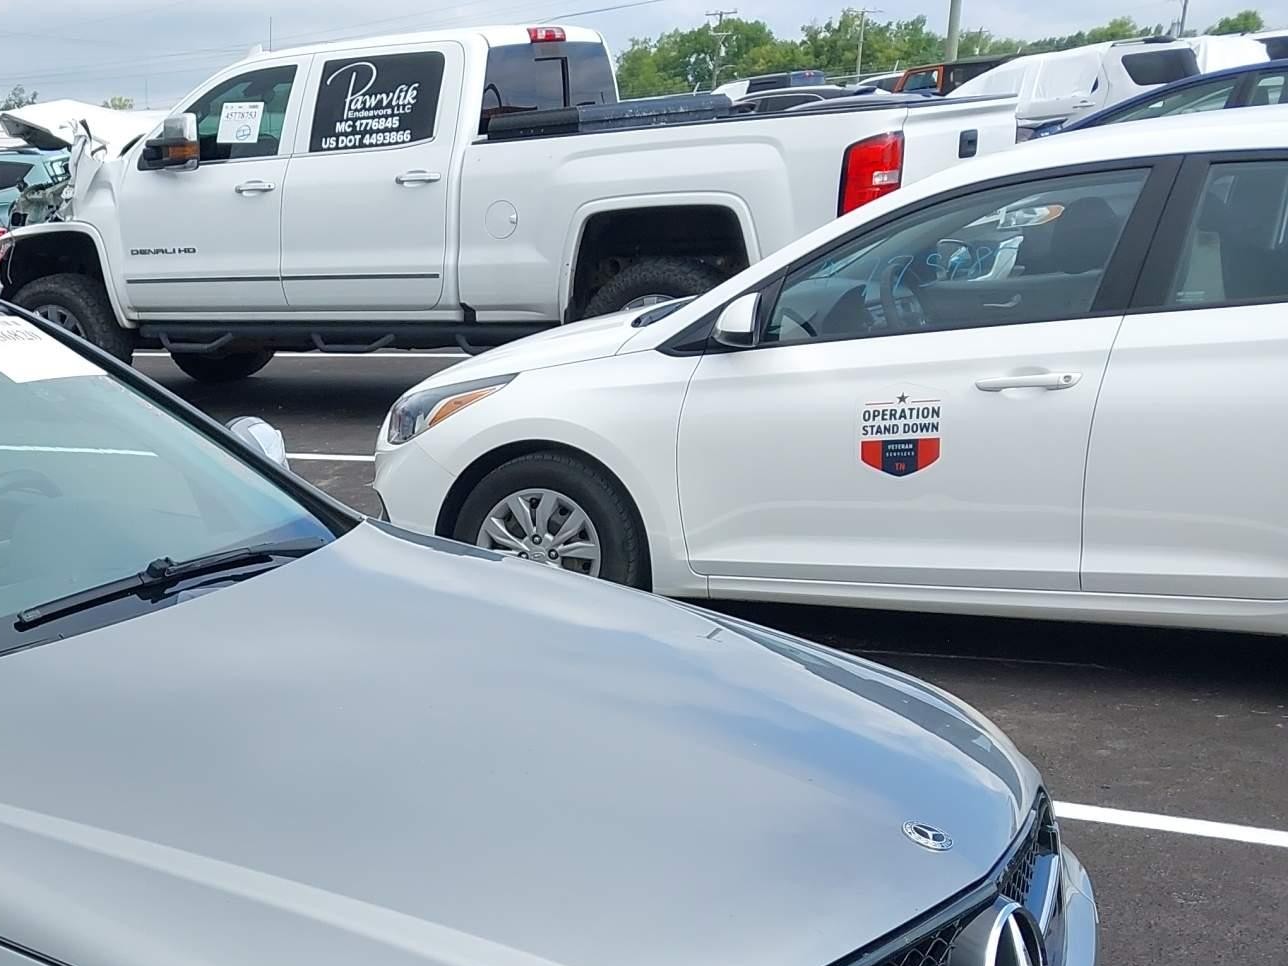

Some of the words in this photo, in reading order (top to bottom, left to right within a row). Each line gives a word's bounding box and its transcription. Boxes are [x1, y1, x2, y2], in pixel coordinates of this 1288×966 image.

[348, 108, 392, 118] Endeavors
[394, 104, 412, 114] LLC
[335, 121, 353, 133] MC
[355, 116, 400, 132] 1776845
[321, 137, 337, 149] US
[338, 134, 362, 148] DOT
[363, 130, 411, 145] 4493866
[130, 247, 176, 256] DENALI
[862, 406, 941, 422] OPERATION
[862, 423, 900, 436] STAND
[902, 421, 940, 434] DOWN
